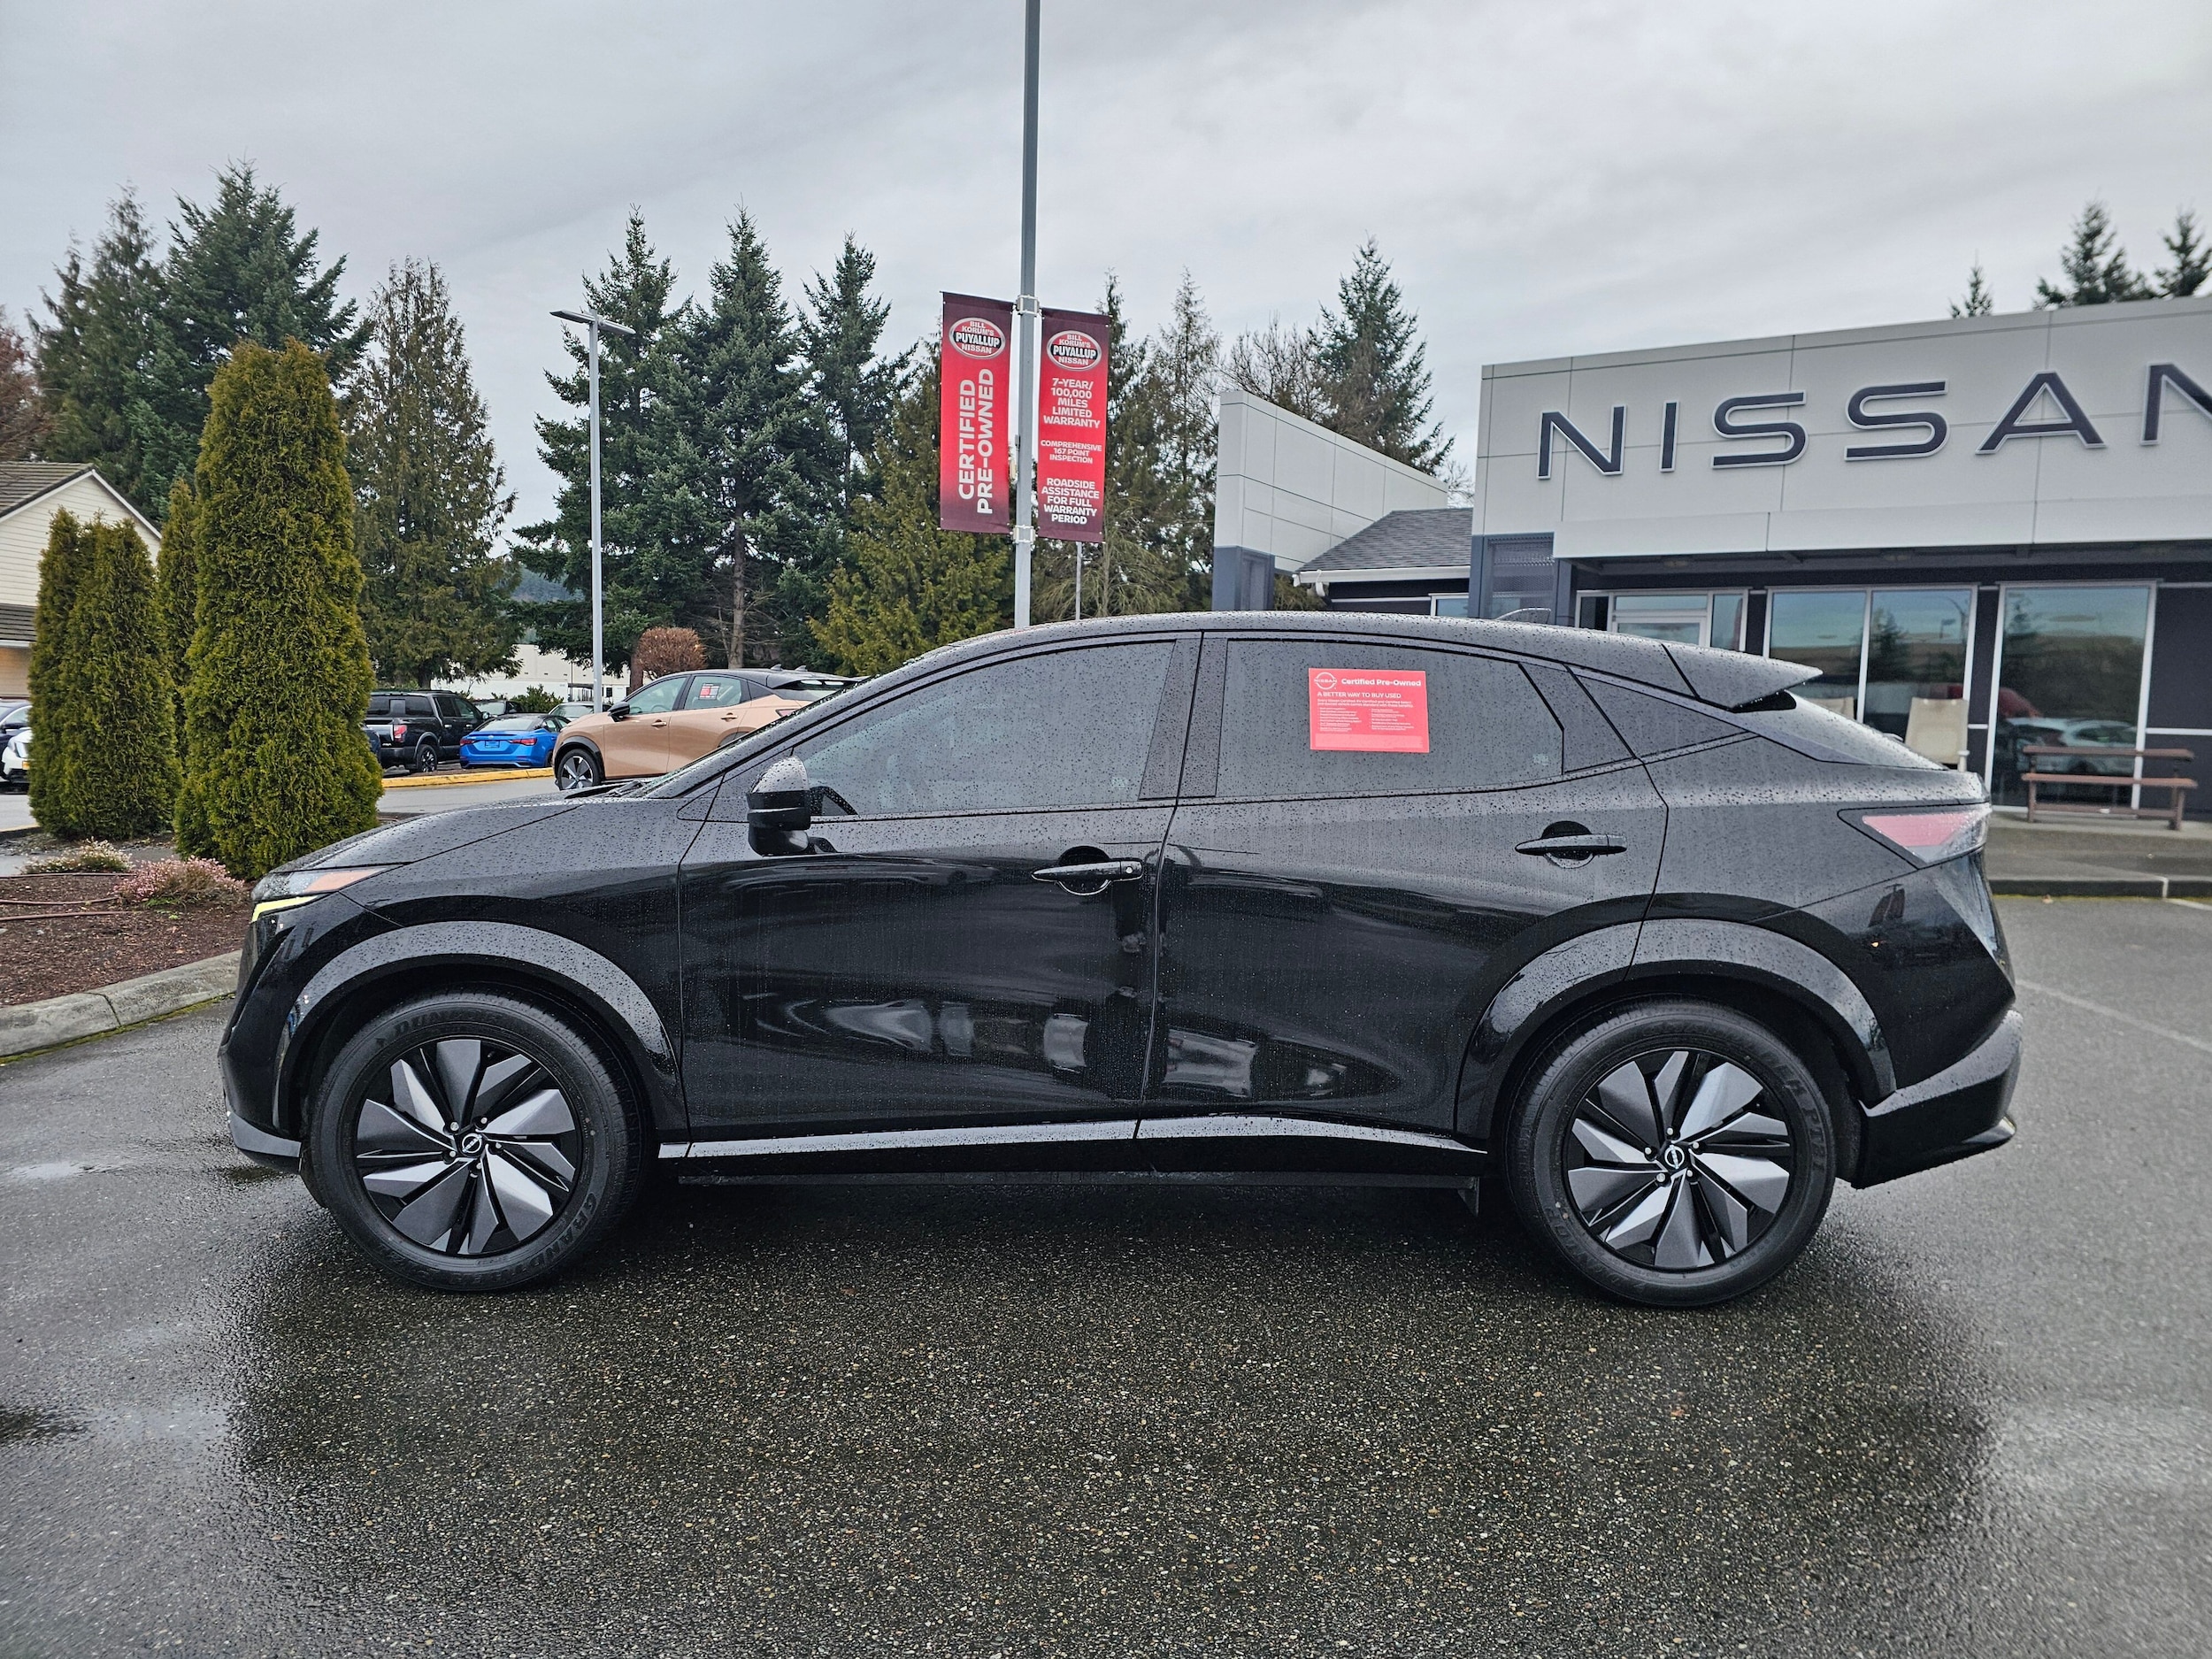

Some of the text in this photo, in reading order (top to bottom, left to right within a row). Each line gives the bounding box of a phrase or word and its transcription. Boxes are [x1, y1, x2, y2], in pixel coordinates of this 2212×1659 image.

[962, 325, 995, 336] KORUM'S
[956, 332, 1000, 348] PUYALLUP
[1058, 338, 1091, 348] KORUM'S
[962, 343, 992, 354] NISSAN
[1053, 345, 1097, 359] PUYALLUP
[1058, 356, 1088, 365] NISSAN
[1051, 378, 1094, 390] 7-YEAR/
[1050, 388, 1092, 399] 100,000
[1057, 397, 1088, 408] MILES
[1052, 406, 1093, 418] LIMITED
[1043, 415, 1101, 429] WARRANTY
[958, 379, 975, 500] CERTIFIED
[977, 368, 994, 514] PRE-OWNED
[1041, 440, 1102, 451] COMPREHENSIVE
[1049, 454, 1093, 464] INSPECTION
[1047, 477, 1095, 489] ROADSIDE
[1041, 486, 1100, 499] ASSISTANCE
[1047, 495, 1092, 508] FOR FULL
[1043, 503, 1097, 517] WARRANTY
[1051, 513, 1087, 525] PERIOD
